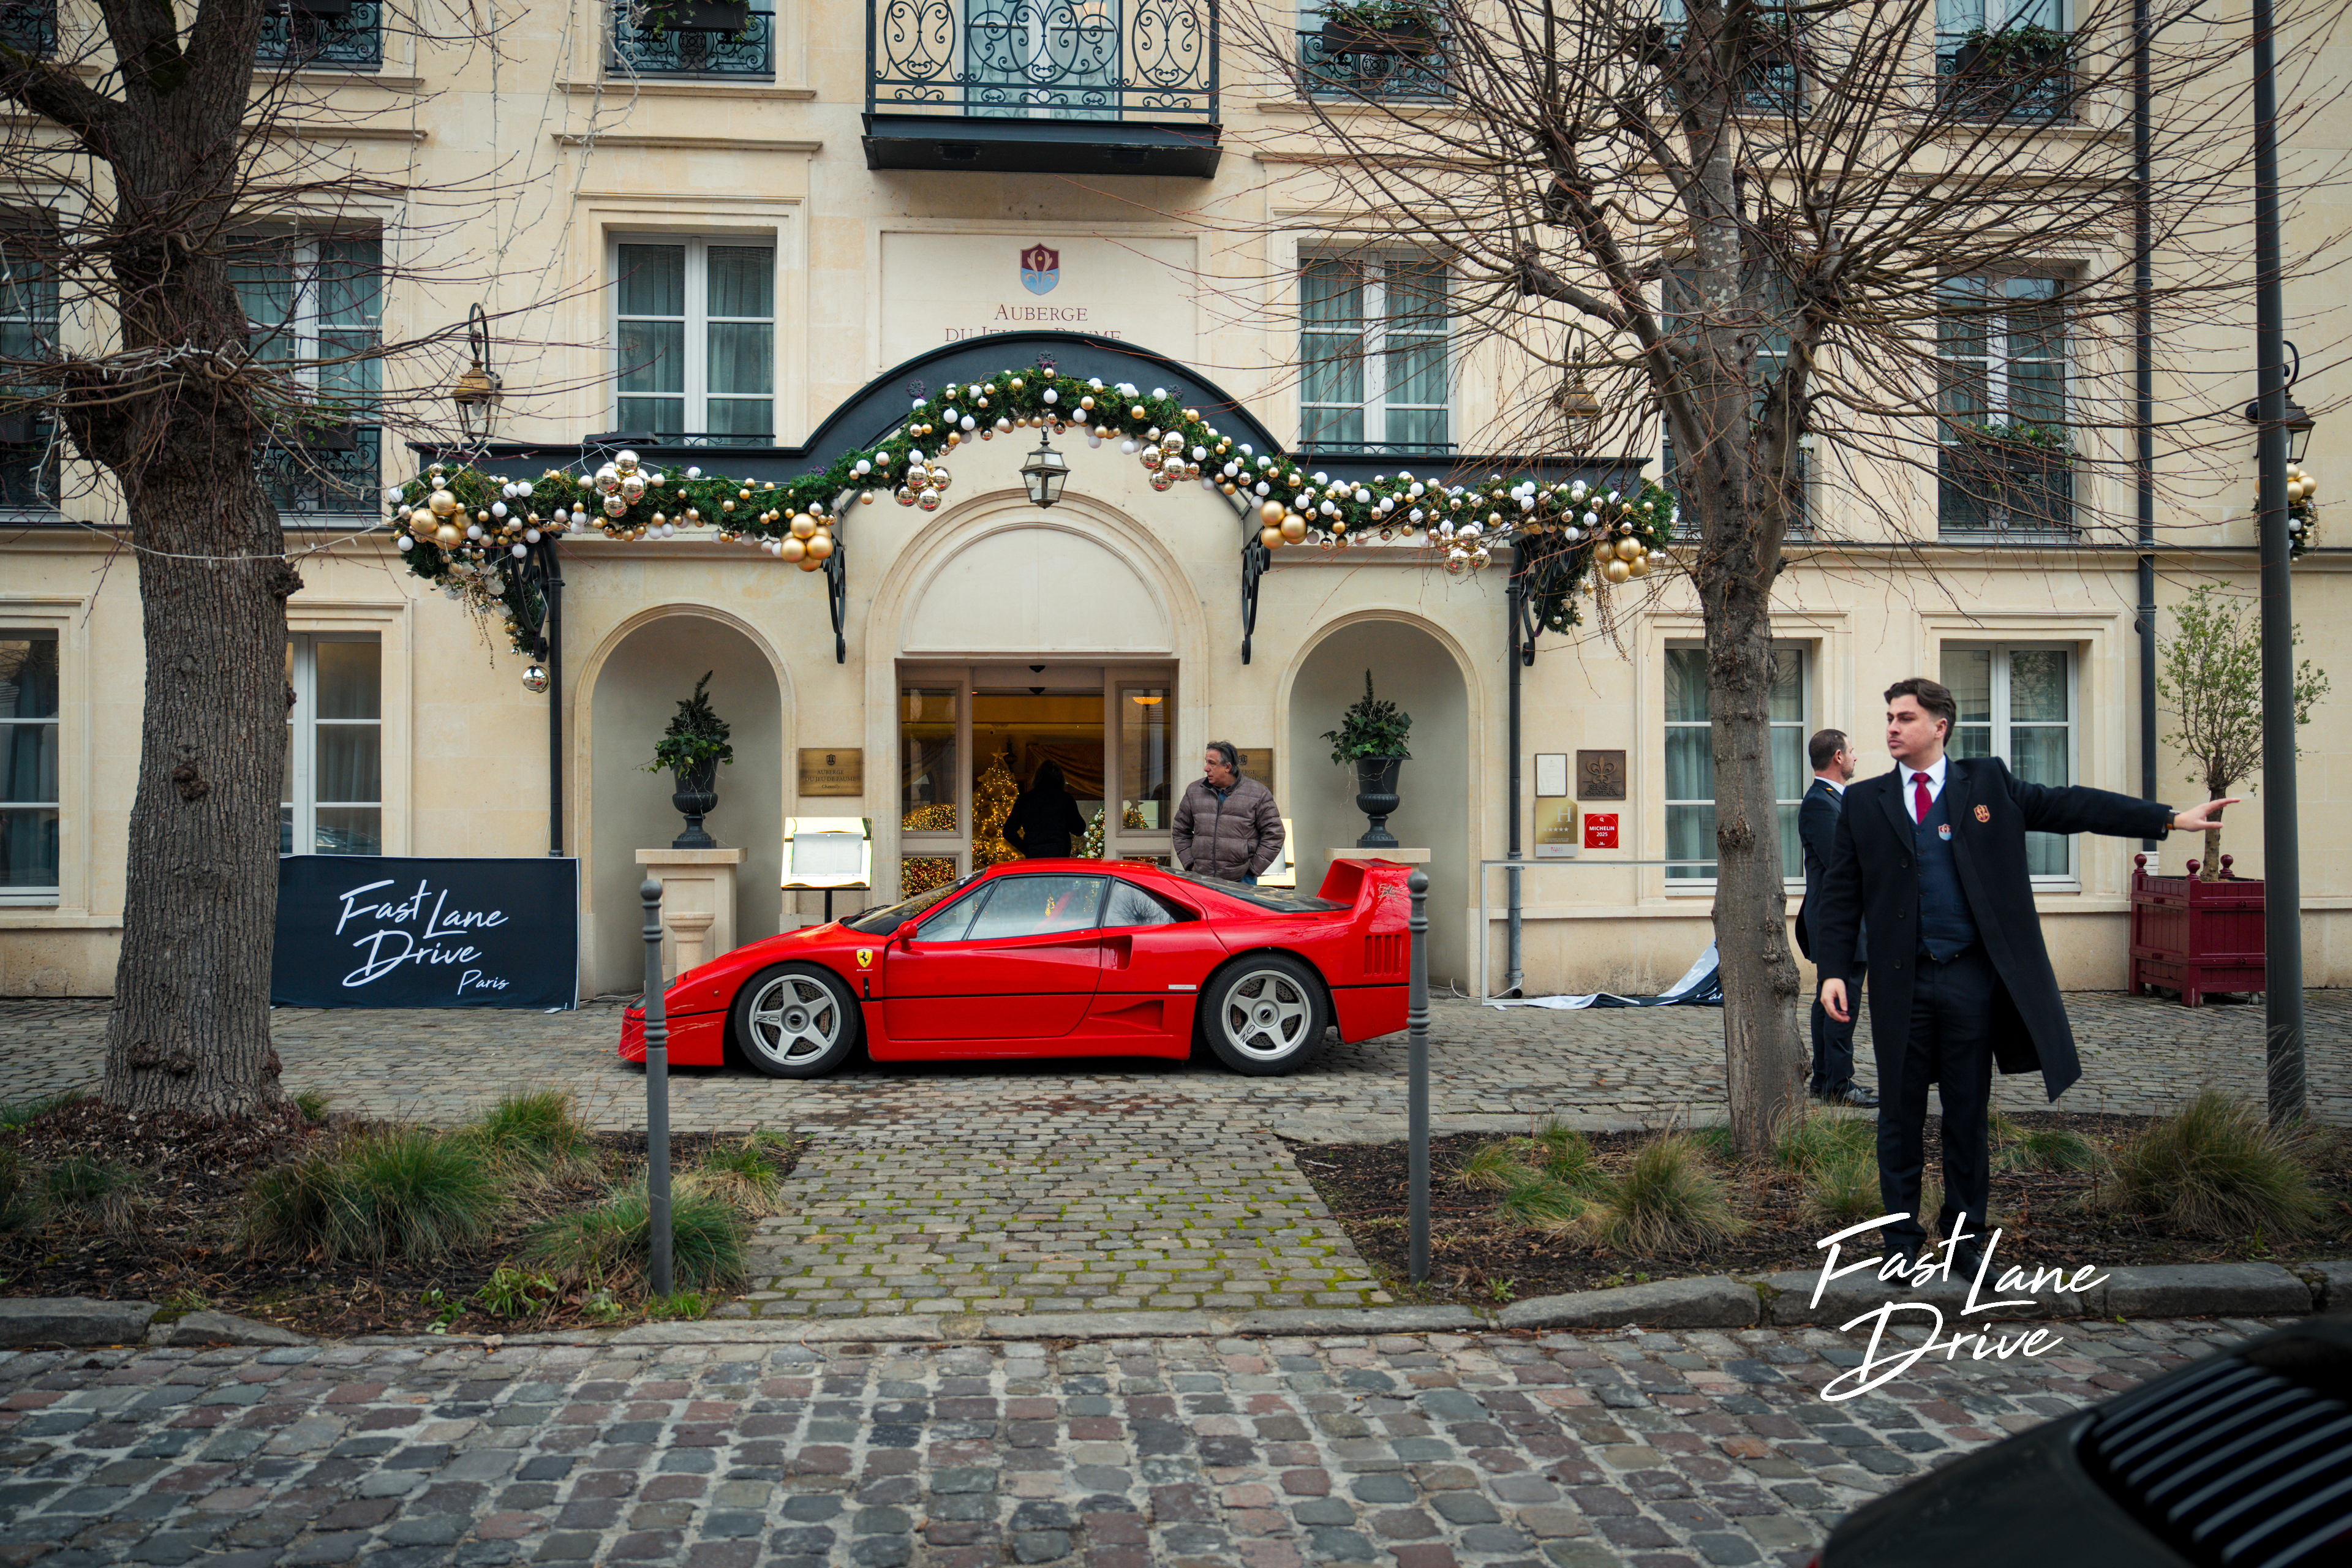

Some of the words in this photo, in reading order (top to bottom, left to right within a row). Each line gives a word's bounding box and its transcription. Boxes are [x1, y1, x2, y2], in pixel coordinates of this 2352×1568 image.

[994, 304, 1088, 321] AUBERGE
[945, 328, 973, 341] DU
[1556, 807, 1572, 822] H
[336, 880, 432, 935] Fast
[423, 889, 508, 939] Lane
[342, 930, 482, 987] Drive
[457, 970, 509, 995] Paris
